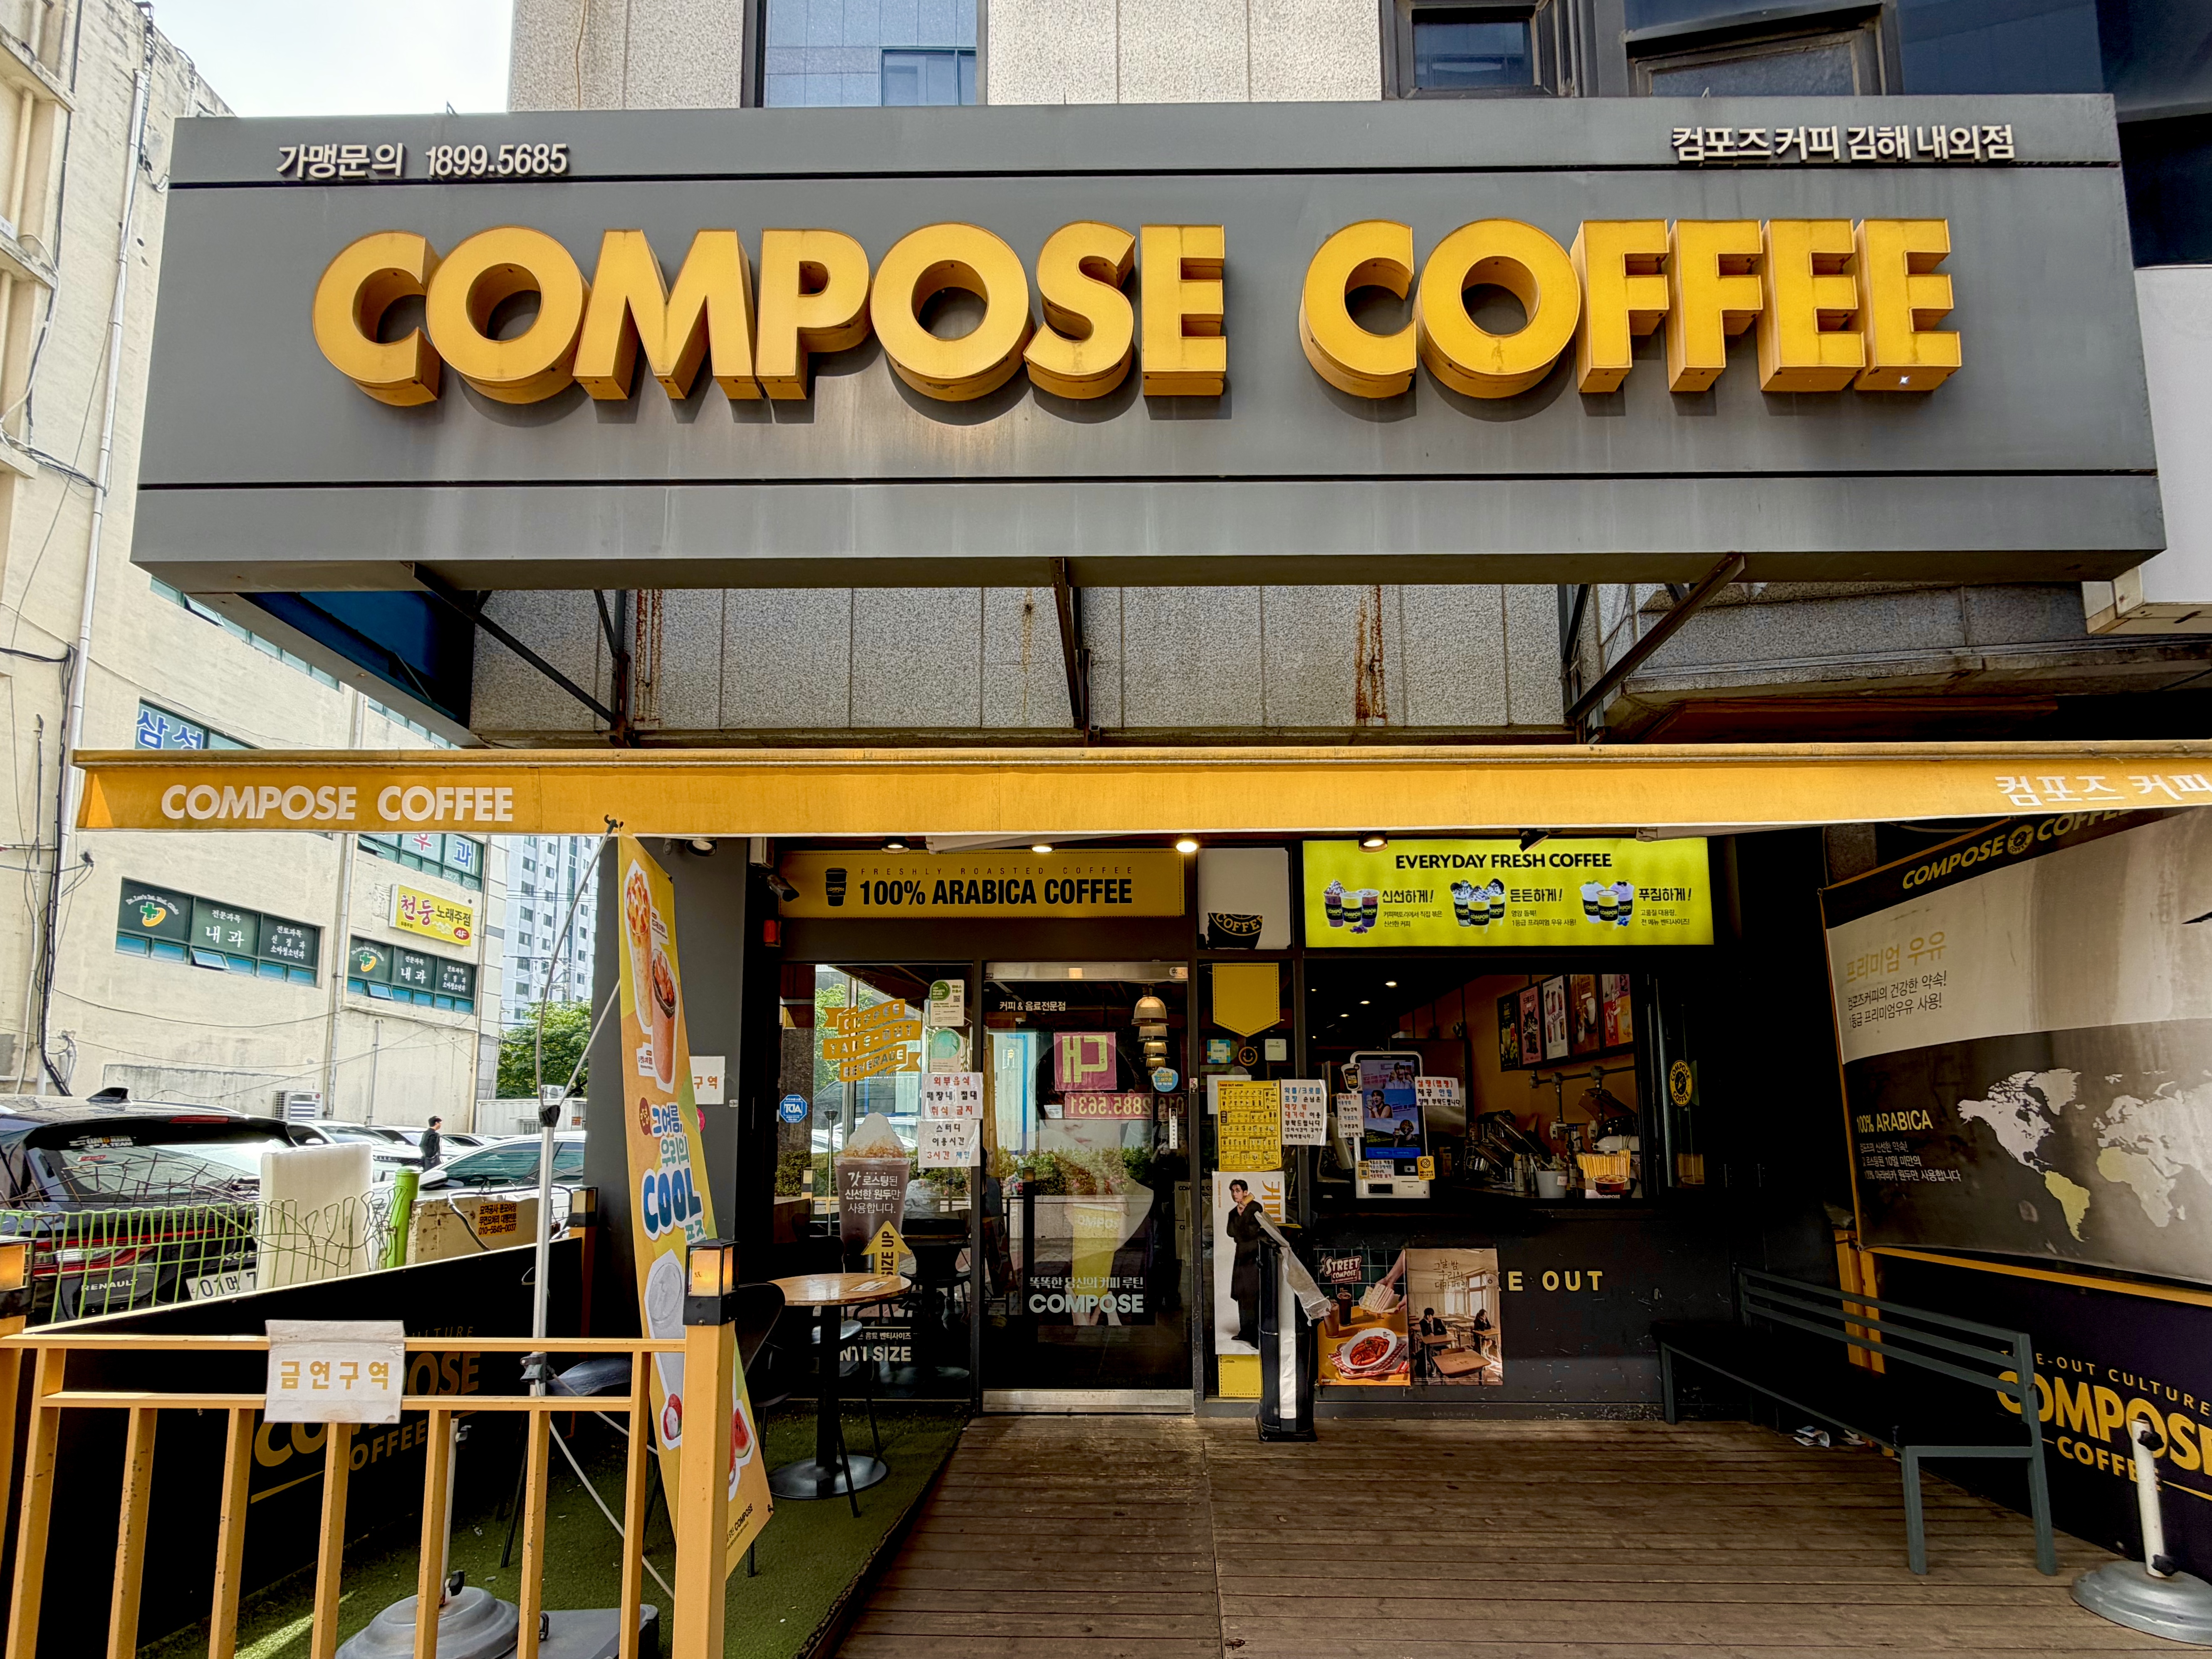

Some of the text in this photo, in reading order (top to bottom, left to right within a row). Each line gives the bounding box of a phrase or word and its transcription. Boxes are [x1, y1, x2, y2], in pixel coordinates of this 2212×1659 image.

[1672, 125, 2015, 161] 컴포즈 커피 김해 내외점
[276, 143, 569, 178] 가맹문의 1899.5685
[313, 218, 1962, 406] COMPOSE COFFEE
[1995, 773, 2212, 806] 컴포즈 커피
[162, 785, 513, 822] COMPOSE COFFEE
[1395, 853, 1612, 869] EVERYDAY FRESH COFFEE
[1903, 834, 2007, 889] COMPOSE
[859, 878, 1132, 905] 100% ARABICA COFFEE
[1382, 889, 1434, 903] 신선하게!
[1510, 888, 1562, 902] 든든하게!
[1638, 887, 1692, 901] 푸짐하게!
[212, 910, 241, 923] 전문과목
[401, 895, 471, 927] 천둥 노래주점
[205, 926, 245, 948] 내과
[455, 929, 466, 938] 4F
[1846, 931, 1947, 983] 프리미엄 우유
[401, 967, 426, 984] 내과
[1890, 978, 1918, 998] 건강한
[1922, 971, 1947, 989] 약속!
[1000, 1001, 1016, 1010] 커피
[1025, 1001, 1066, 1011] 음료전문점
[1918, 993, 1942, 1011] 사용!
[844, 1003, 900, 1030] COFFEE
[1671, 1063, 1690, 1081] COMPOSE
[693, 1076, 718, 1089] 구역
[934, 1076, 970, 1086] 외부음식
[927, 1091, 977, 1101] 매장내 절대
[1673, 1090, 1690, 1103] COFFEE
[931, 1105, 973, 1115] 취식 금지
[936, 1124, 961, 1133] 스터디
[1856, 1110, 1933, 1133] 100% ARABICA
[932, 1137, 965, 1146] 이용시간
[927, 1151, 950, 1160] 3시간
[1900, 1156, 1922, 1167] 미만의
[848, 1171, 898, 1187] 갓 로스팅된
[1898, 1170, 1920, 1181] 원두만
[1921, 1169, 1962, 1182] 사용합니다
[643, 1168, 702, 1234] COOL
[845, 1189, 901, 1200] 신선한 원두만
[848, 1203, 896, 1214] 사용합니다.
[881, 1231, 894, 1275] SIZE UP
[1326, 1257, 1360, 1275] STREET
[1433, 1259, 1448, 1270] 그날
[1333, 1269, 1356, 1278] COMPOSE
[1439, 1270, 1463, 1280] 우리의
[1542, 1270, 1603, 1291] OUT
[81, 1279, 138, 1291] RENAULT
[1029, 1277, 1143, 1289] 똑똑한 당신의 커피 루틴
[1029, 1293, 1144, 1313] COMPOSE
[873, 1346, 911, 1361] SIZE
[281, 1361, 389, 1390] 금연구역
[2108, 1369, 2211, 1417] CULTURE
[349, 1419, 426, 1471] OFFEE
[2057, 1436, 2162, 1491] COFFE
[735, 1503, 753, 1531] COMPOSE
